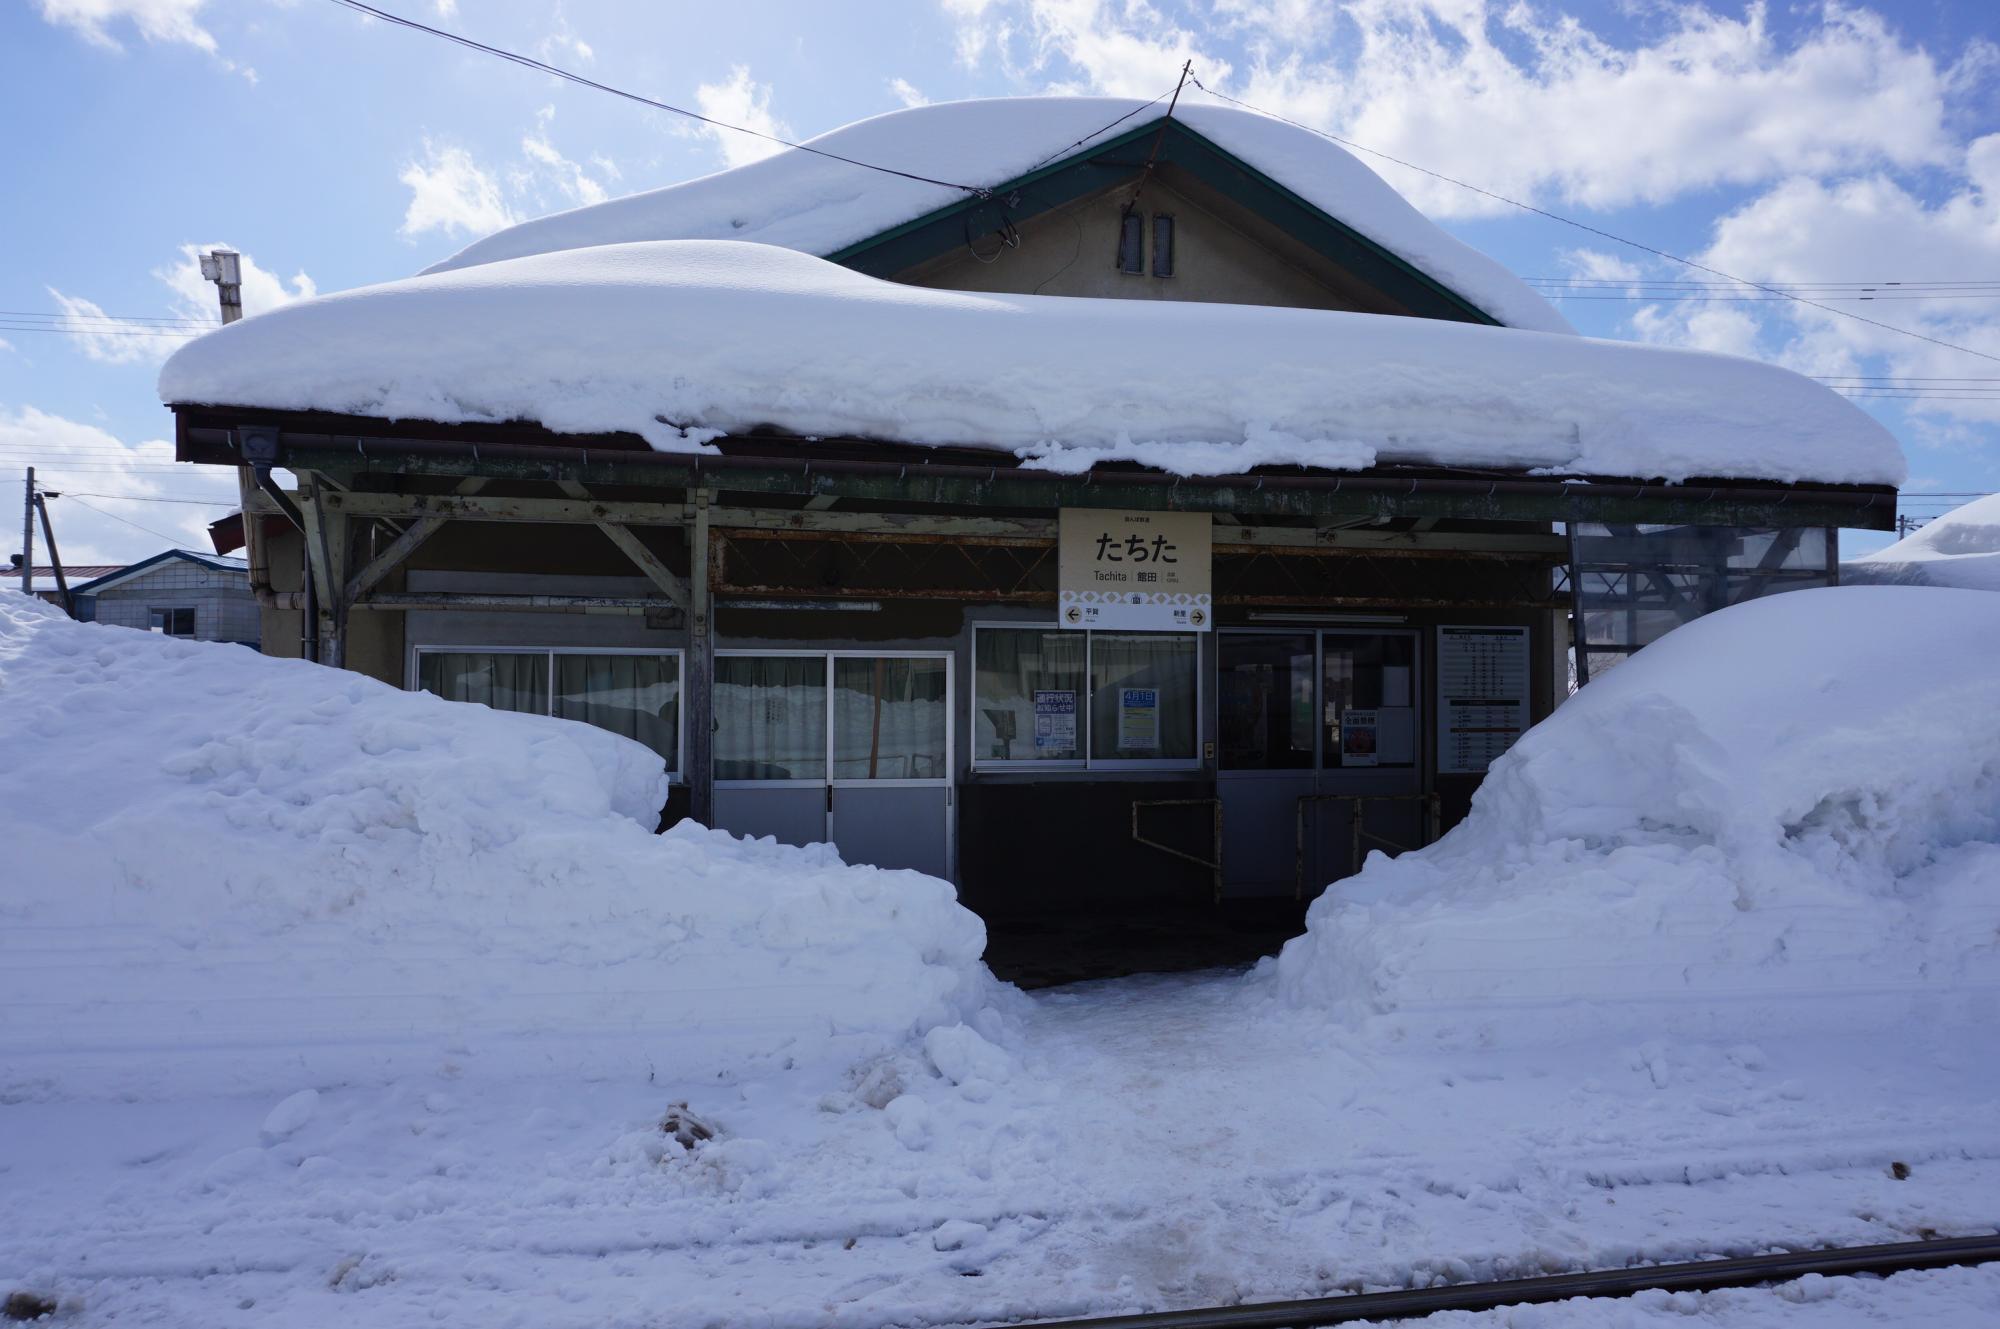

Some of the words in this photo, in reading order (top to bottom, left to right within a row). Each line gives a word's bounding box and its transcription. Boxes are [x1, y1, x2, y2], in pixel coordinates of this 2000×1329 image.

[1096, 532, 1178, 563] たちた
[1094, 570, 1127, 582] Tachita
[1137, 571, 1157, 582] 館田
[1036, 693, 1073, 703] 運行状況
